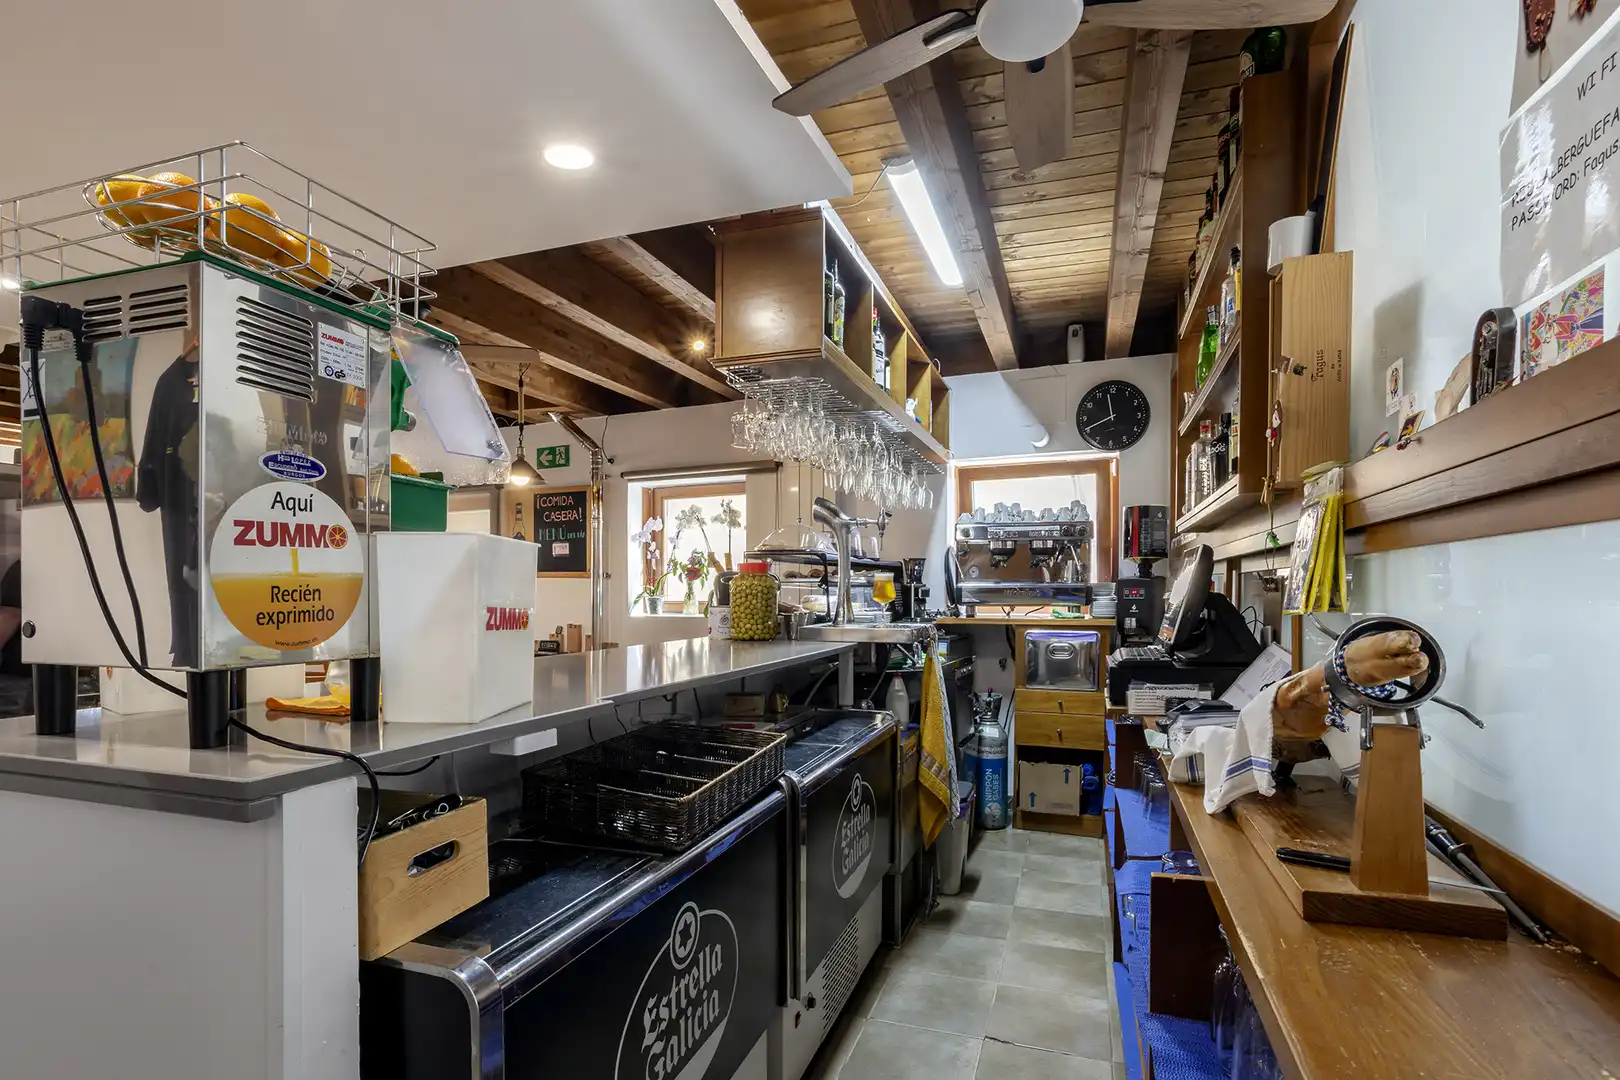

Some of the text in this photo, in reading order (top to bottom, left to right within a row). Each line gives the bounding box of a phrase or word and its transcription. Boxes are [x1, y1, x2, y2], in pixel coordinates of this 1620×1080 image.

[1577, 51, 1618, 101] WI FI
[1310, 349, 1327, 382] Fagus
[283, 471, 306, 479] BURGOS
[270, 491, 314, 517] Aquí
[543, 506, 583, 522] CASERA!
[233, 519, 348, 549] ZUMMO
[271, 584, 321, 603] Recién
[256, 605, 335, 630] exprimido
[485, 606, 529, 631] ZUMMO
[985, 768, 993, 801] NIPPON
[841, 803, 870, 848] Estrella
[842, 829, 869, 875] Galicia
[641, 943, 723, 1053] Estrella
[645, 989, 720, 1080] Galicia
